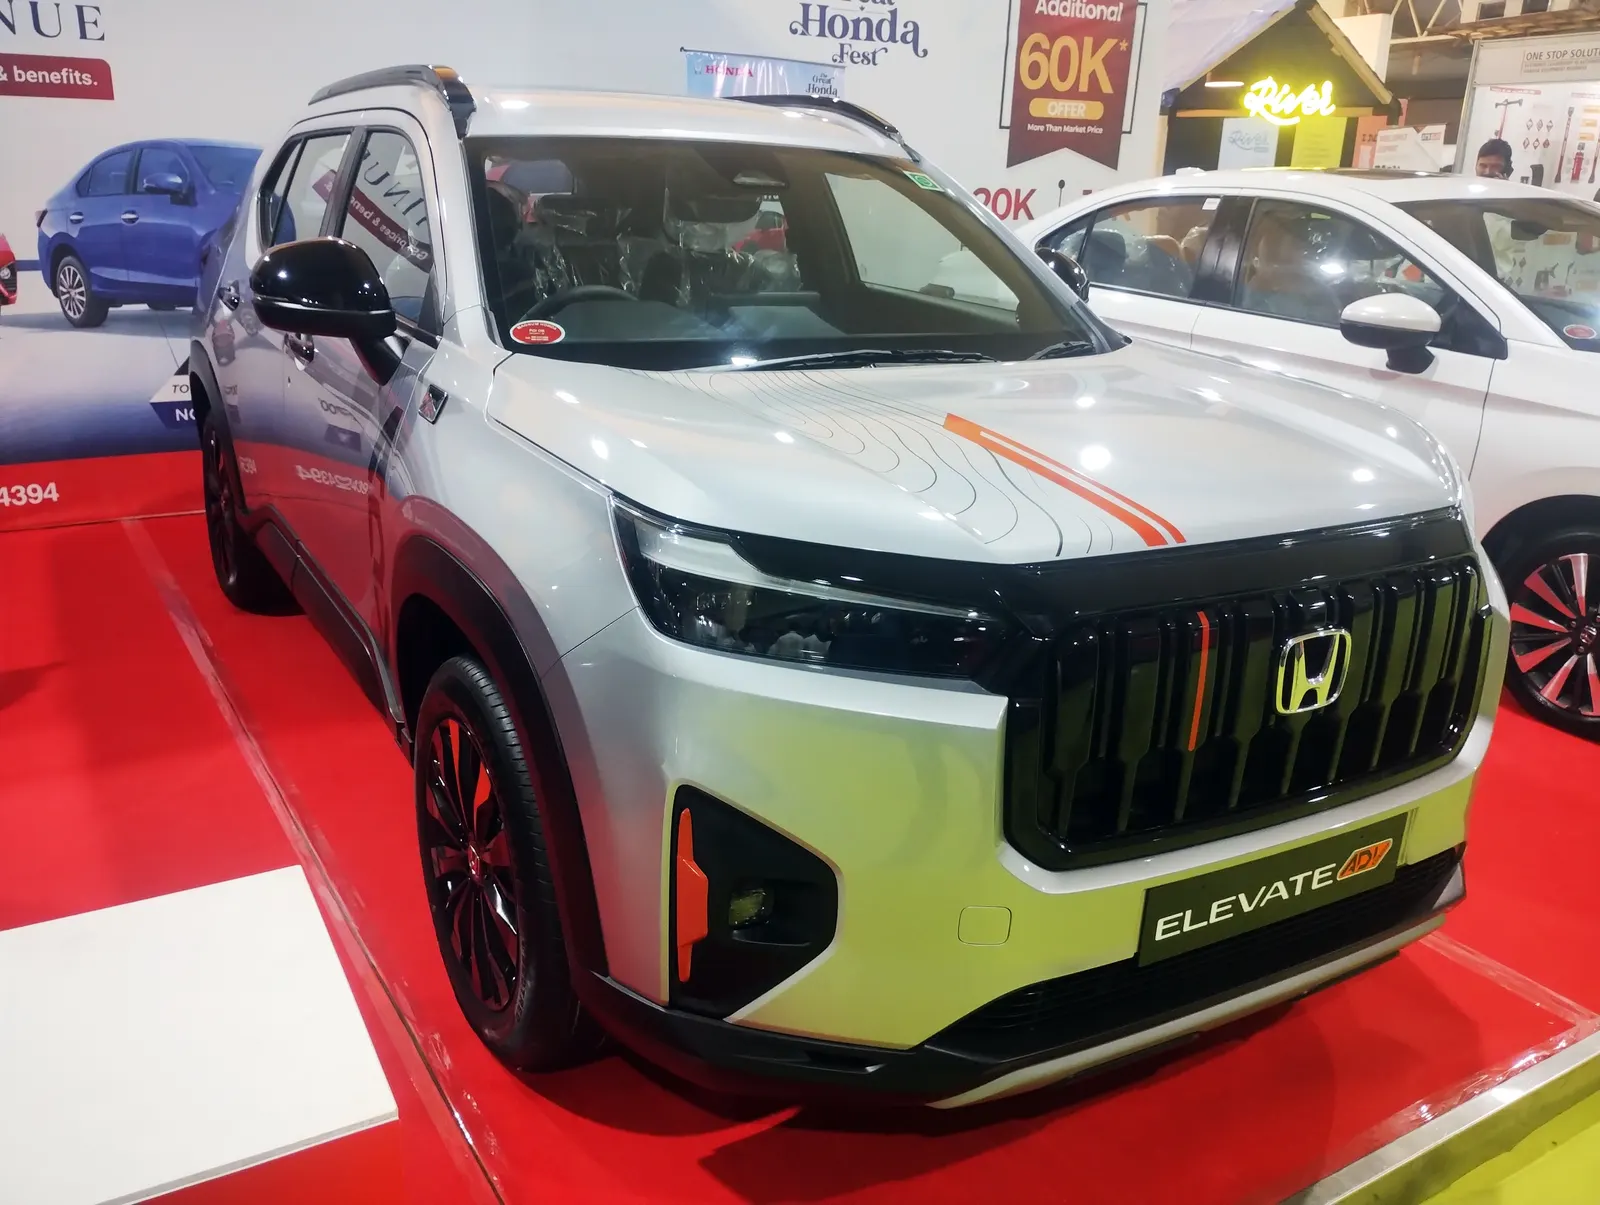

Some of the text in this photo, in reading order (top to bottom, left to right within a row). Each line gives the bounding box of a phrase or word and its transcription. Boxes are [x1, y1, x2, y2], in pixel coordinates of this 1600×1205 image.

[1034, 0, 1124, 22] Additional
[789, 2, 928, 58] Honda
[831, 42, 889, 66] Fest
[1526, 51, 1544, 61] ONE
[1546, 49, 1568, 60] STOP
[13, 65, 99, 86] benefits.
[1047, 101, 1087, 117] OFFER
[1027, 123, 1104, 135] More Than Market Price
[0, 481, 60, 507] 4394
[1154, 863, 1337, 941] ELEVATE
